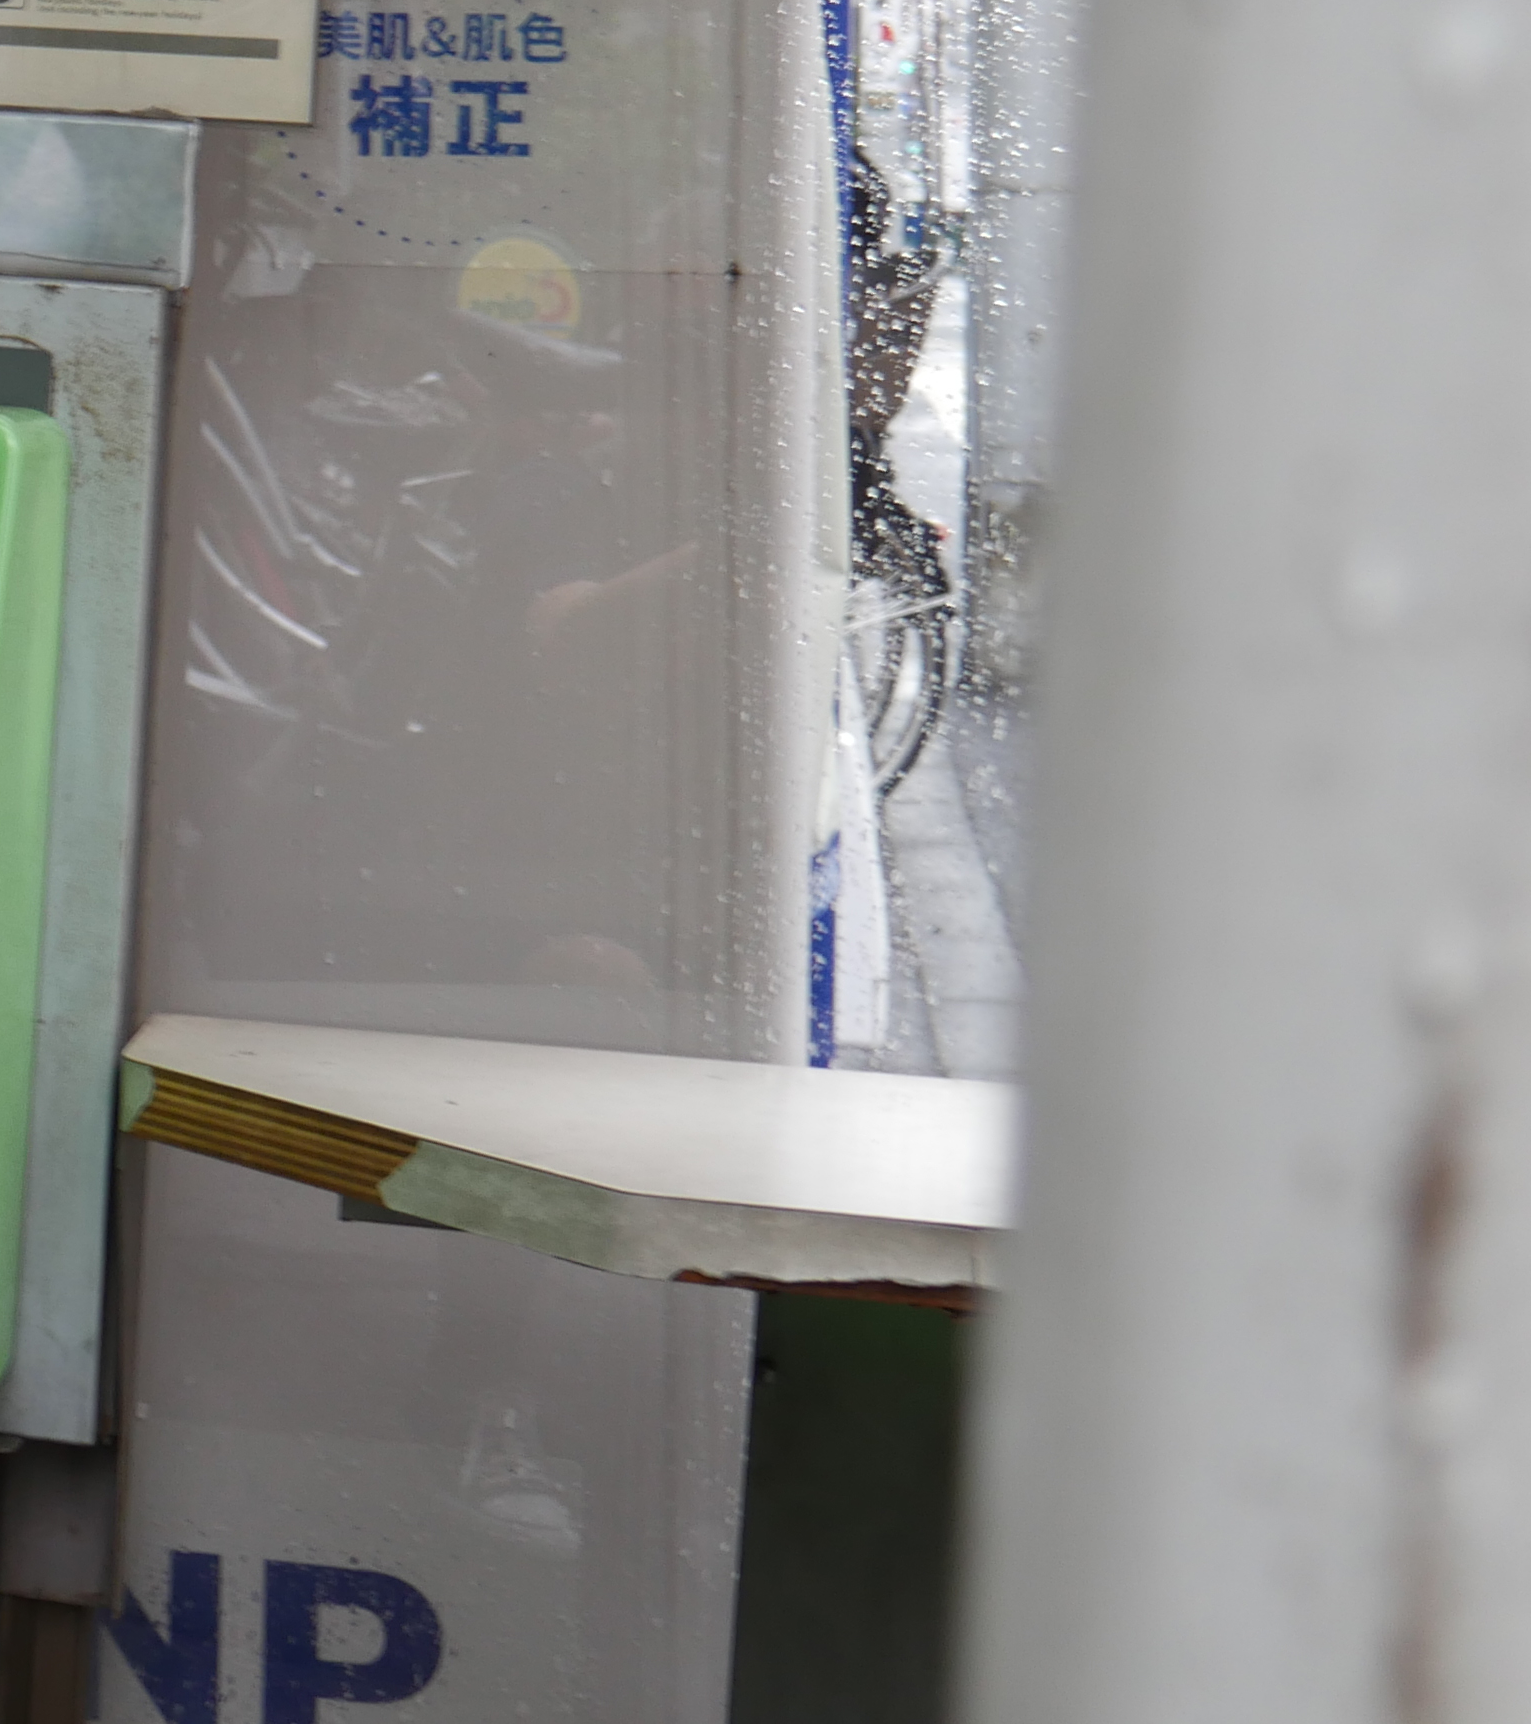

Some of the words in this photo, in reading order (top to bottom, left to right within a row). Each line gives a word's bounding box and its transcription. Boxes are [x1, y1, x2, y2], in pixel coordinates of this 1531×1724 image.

[316, 9, 570, 65] 美肌&肌色
[348, 73, 534, 160] 補正
